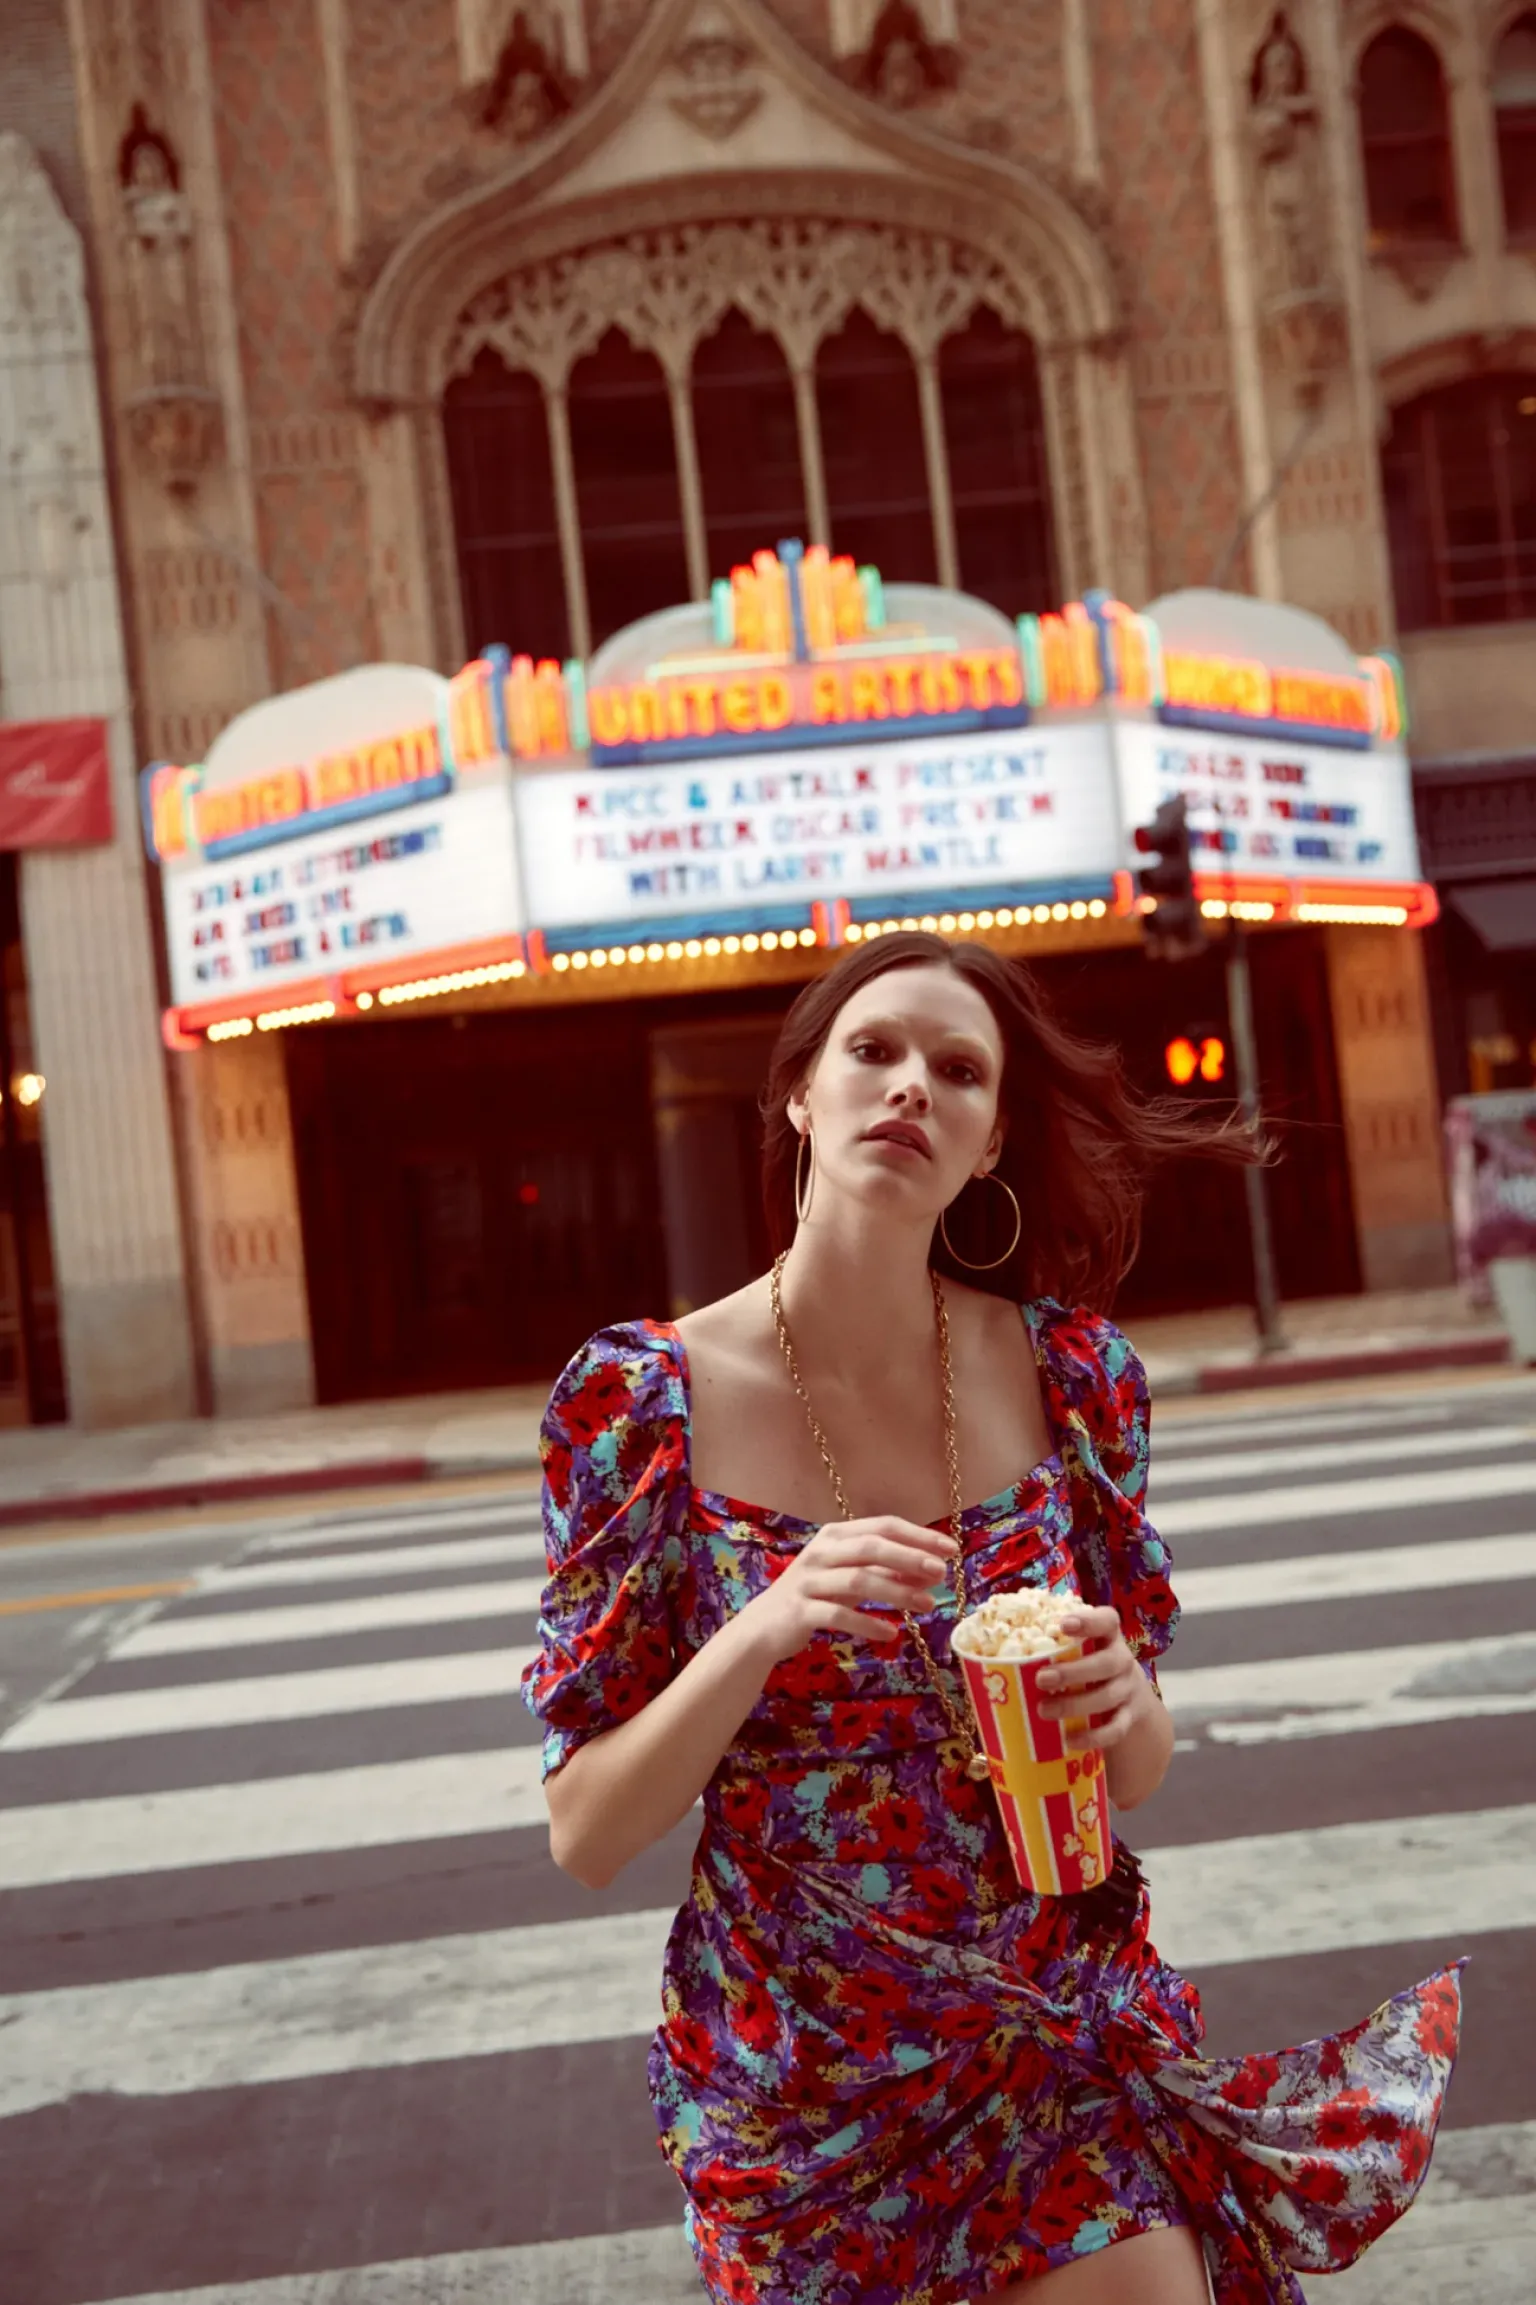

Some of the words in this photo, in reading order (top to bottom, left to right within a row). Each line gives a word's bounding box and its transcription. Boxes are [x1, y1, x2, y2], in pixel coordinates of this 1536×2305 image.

[589, 672, 791, 745] UNITED
[810, 651, 1022, 722] ARTISTS
[897, 749, 1046, 788] PRESENT
[772, 807, 881, 845] OSCAR
[628, 864, 720, 896] WITH
